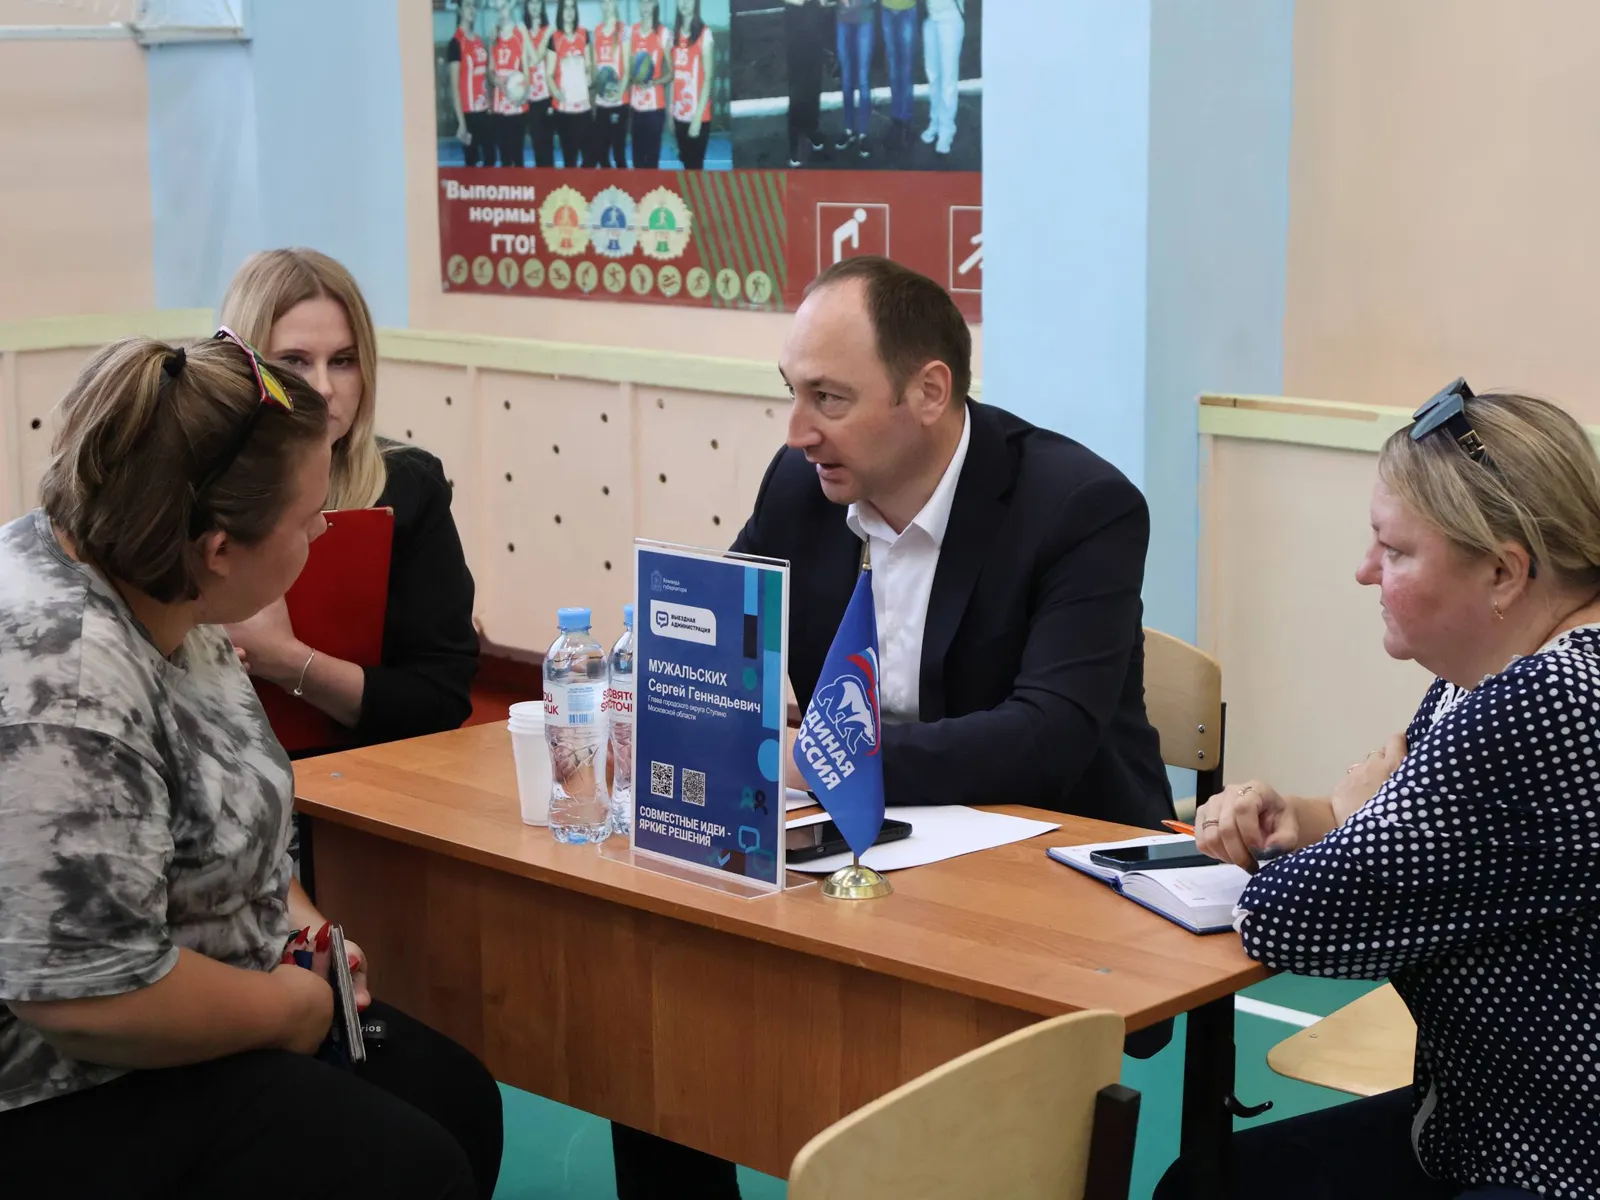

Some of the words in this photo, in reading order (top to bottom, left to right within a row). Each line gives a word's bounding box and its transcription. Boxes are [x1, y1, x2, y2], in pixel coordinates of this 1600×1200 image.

[446, 180, 535, 202] Выполни
[469, 206, 536, 226] нормы
[490, 233, 536, 255] ГТО!
[671, 614, 696, 623] ВЫЕЗДНАЯ
[671, 621, 711, 634] АДМИНИСТРАЦИЯ
[648, 658, 728, 687] МУЖАЛЬСКИХ
[647, 695, 662, 704] Глава
[662, 699, 689, 710] городского
[705, 707, 727, 718] Ступино
[648, 678, 686, 698] Сергей
[688, 685, 761, 714] Геннадьевич
[647, 704, 676, 716] Московской
[676, 710, 697, 721] области
[797, 719, 842, 791] ОССИЯ
[638, 818, 667, 836] ЯРКИЕ
[668, 827, 711, 847] РЕШЕНИЯ
[639, 805, 699, 831] СОВМЕСТНЫЕ
[700, 820, 726, 838] ИДЕИ
